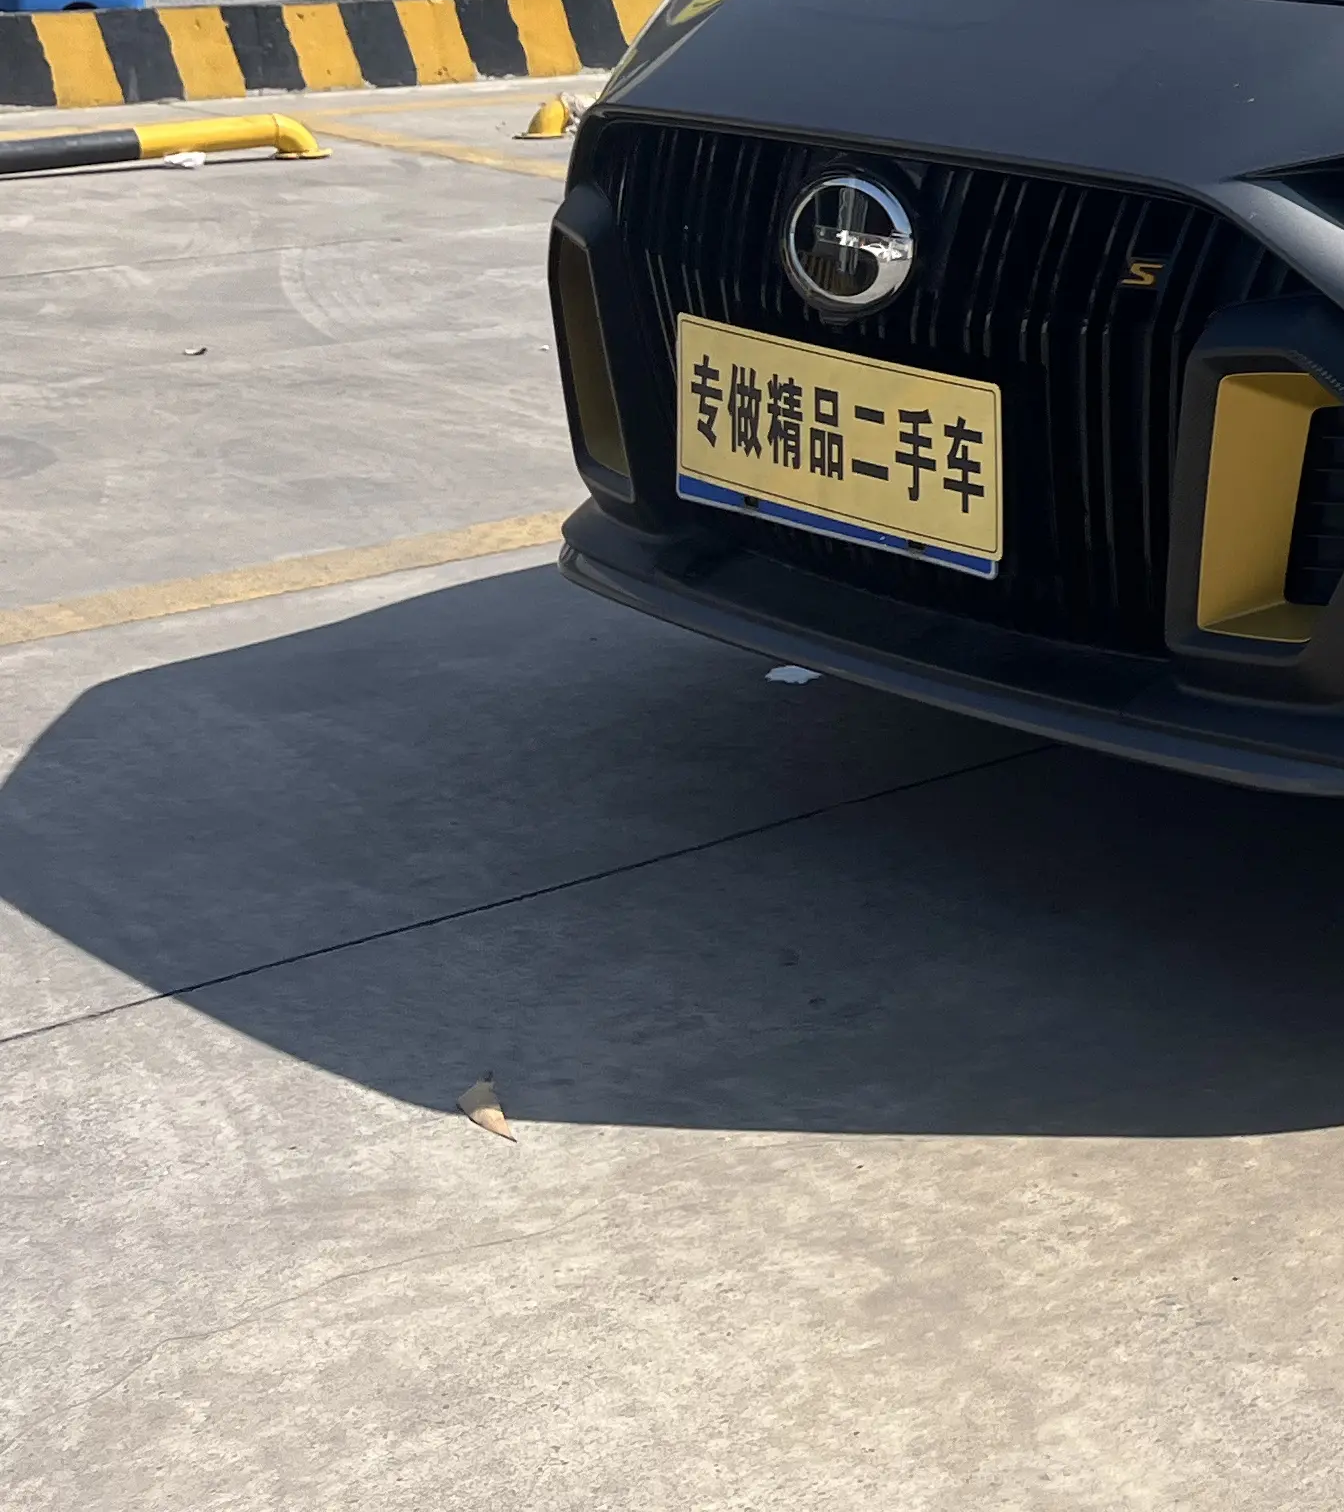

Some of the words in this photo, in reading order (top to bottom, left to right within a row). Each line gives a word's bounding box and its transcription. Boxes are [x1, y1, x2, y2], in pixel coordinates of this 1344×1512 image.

[1120, 263, 1164, 286] S
[691, 354, 985, 515] 专做精品二手车
